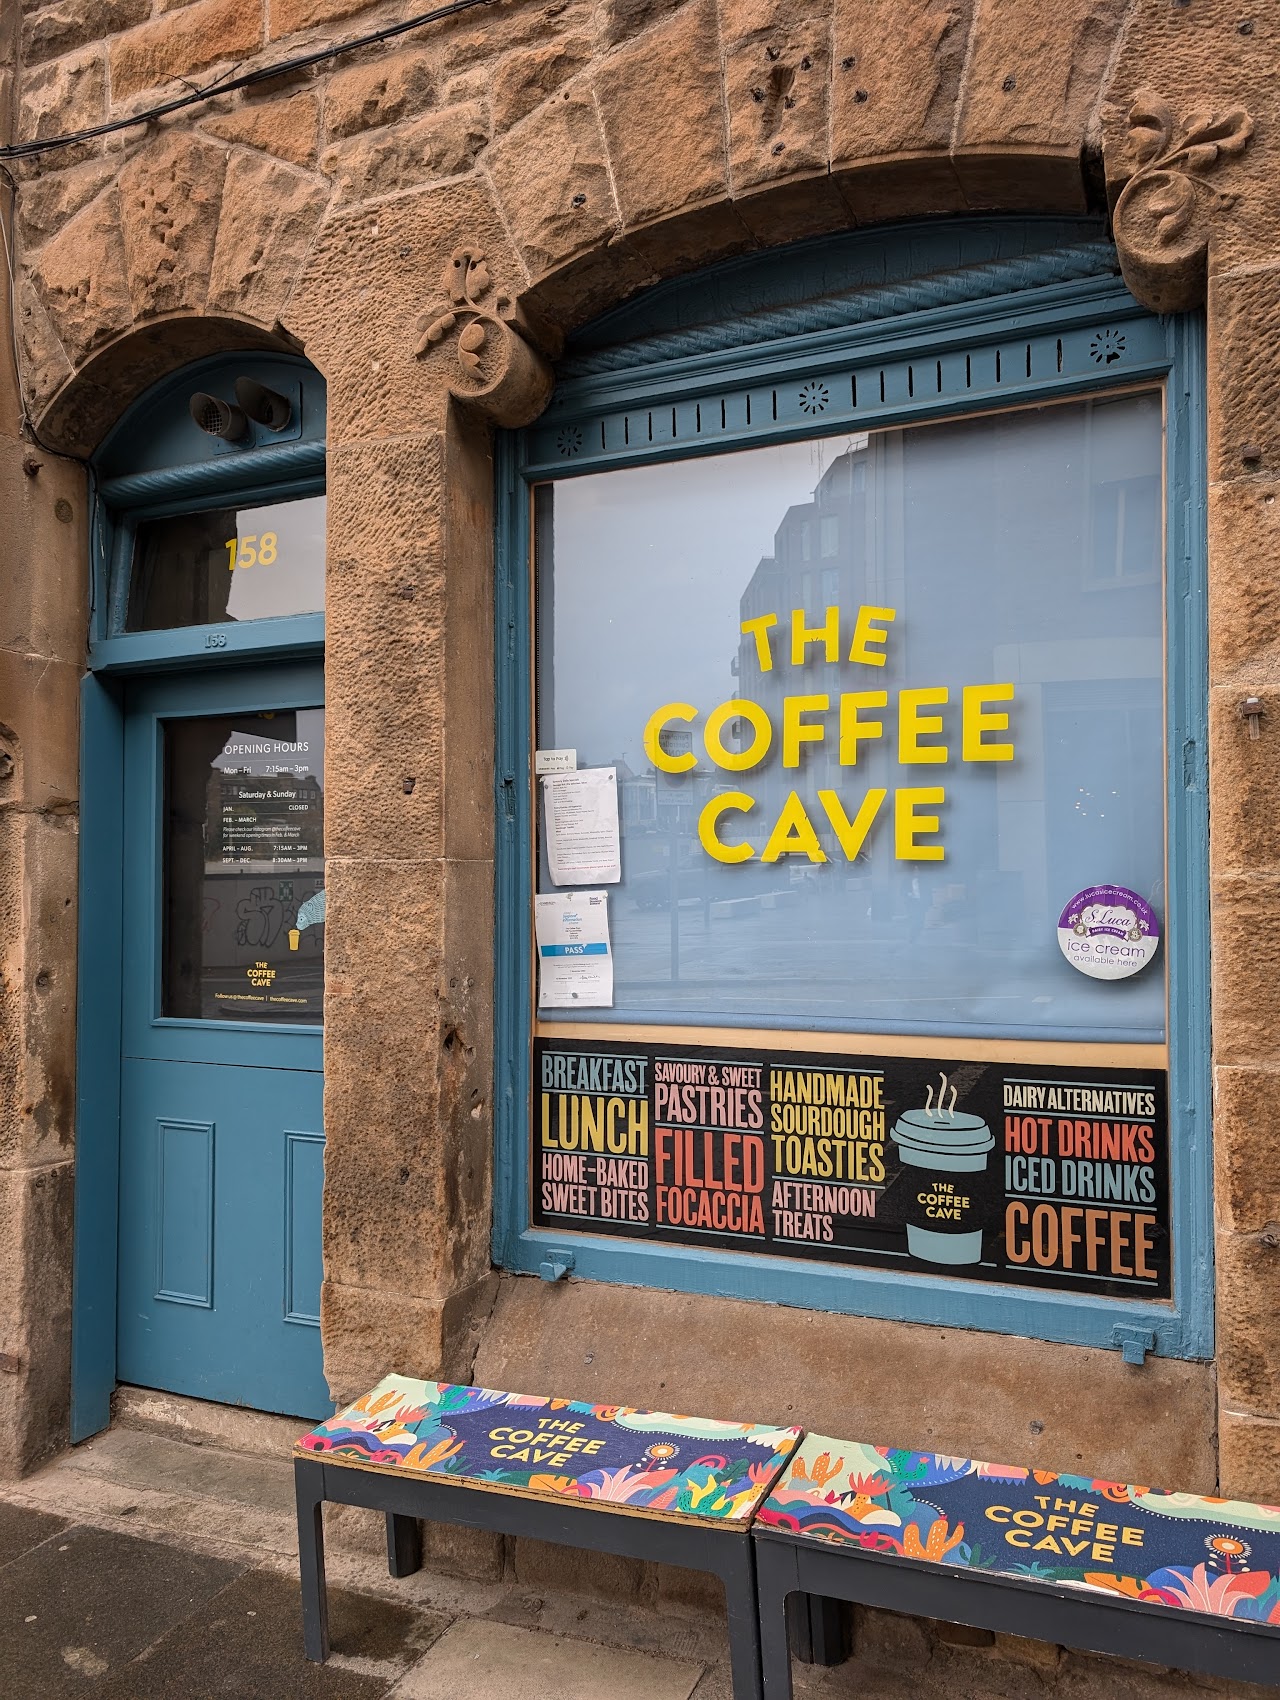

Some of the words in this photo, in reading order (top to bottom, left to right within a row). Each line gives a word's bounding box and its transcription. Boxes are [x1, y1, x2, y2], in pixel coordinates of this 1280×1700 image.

[225, 532, 277, 570] 158
[740, 605, 896, 672] THE
[643, 682, 1014, 773] COFFEE
[224, 743, 270, 755] OPENING
[274, 742, 309, 752] HOURS
[266, 765, 288, 773] 7:15am
[294, 765, 308, 773] 3pm
[239, 791, 266, 799] Saturday
[273, 790, 296, 798] Sunday
[697, 786, 945, 863] CAVE
[1072, 889, 1148, 915] www.lucasicecream.co.uk
[1096, 910, 1131, 927] Luca
[565, 946, 583, 954] PASS
[1067, 938, 1090, 952] ice
[1095, 943, 1145, 957] cream
[1073, 955, 1114, 964] available
[1117, 959, 1137, 967] here
[247, 969, 276, 978] COFFEE
[251, 978, 271, 986] CAVE
[541, 1055, 648, 1094] BREAKFAST
[654, 1062, 707, 1085] SAVOURY
[708, 1065, 720, 1085] &
[722, 1066, 762, 1089] SWEET
[770, 1070, 885, 1110] HANDMADE
[654, 1083, 764, 1129] PASTRIES
[1003, 1085, 1046, 1109] DAIRY
[1047, 1087, 1155, 1116] ALTERNATIVES
[541, 1092, 648, 1156] LUNCH
[770, 1104, 885, 1141] SOURDOUGH
[1005, 1116, 1052, 1155] HOT
[1058, 1119, 1155, 1163] DRINKS
[542, 1153, 648, 1190] HOME-BAKED
[654, 1128, 765, 1193] FILLED
[771, 1135, 885, 1182] TOASTIES
[932, 1183, 954, 1194] THE
[1005, 1155, 1056, 1194] ICED
[1061, 1159, 1156, 1203] DRINKS
[541, 1182, 598, 1216] SWEET
[601, 1188, 649, 1222] BITES
[655, 1186, 765, 1234] FOCACCIA
[772, 1181, 876, 1218] AFTERNOON
[917, 1192, 970, 1209] COFFEE
[925, 1207, 962, 1221] CAVE
[772, 1210, 833, 1241] TREATS
[1005, 1201, 1158, 1279] COFFEE
[488, 1427, 606, 1455] COFFEE
[538, 1418, 585, 1434] THE
[490, 1444, 573, 1467] CAVE
[1034, 1495, 1099, 1518] THE
[984, 1505, 1145, 1547] COFFEE
[1004, 1529, 1115, 1563] CAVE
